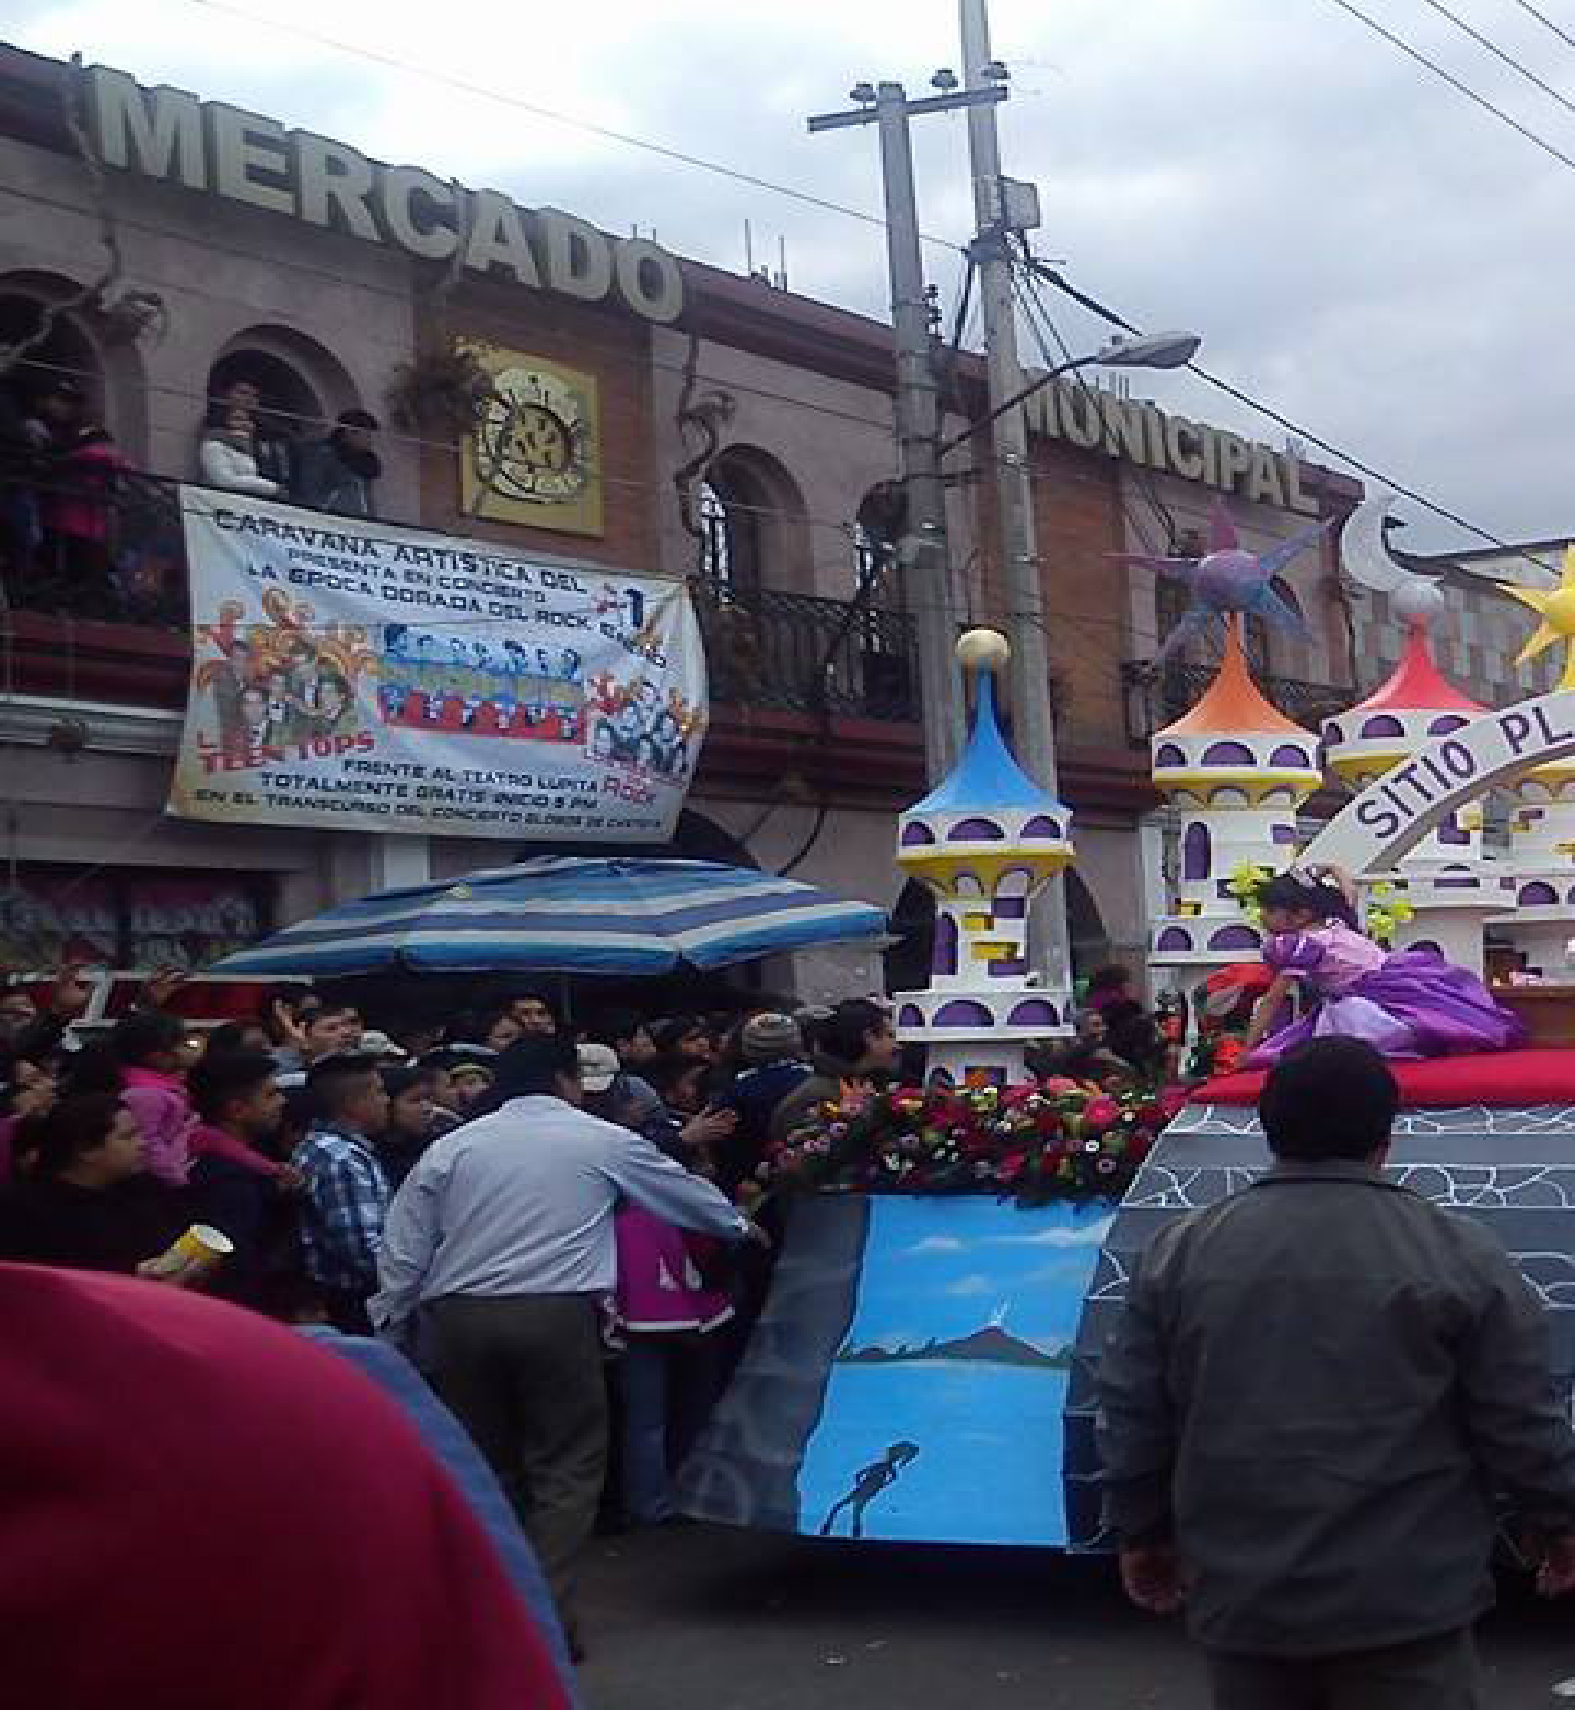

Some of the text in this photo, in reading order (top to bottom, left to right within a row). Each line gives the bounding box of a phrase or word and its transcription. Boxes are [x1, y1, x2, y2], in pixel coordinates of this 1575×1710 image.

[92, 64, 684, 324] MERCADO
[1022, 378, 1320, 509] MUNICIPAL
[215, 510, 587, 594] CARAVANA ARTISTICA DEL
[248, 564, 278, 580] LA
[489, 602, 528, 622] DEL
[260, 771, 408, 797] TOTALMENTE
[416, 785, 487, 803] GRATIS
[265, 793, 390, 814] TRANSCURSO
[343, 759, 427, 778] FRENTE
[1357, 741, 1476, 840] SITIO
